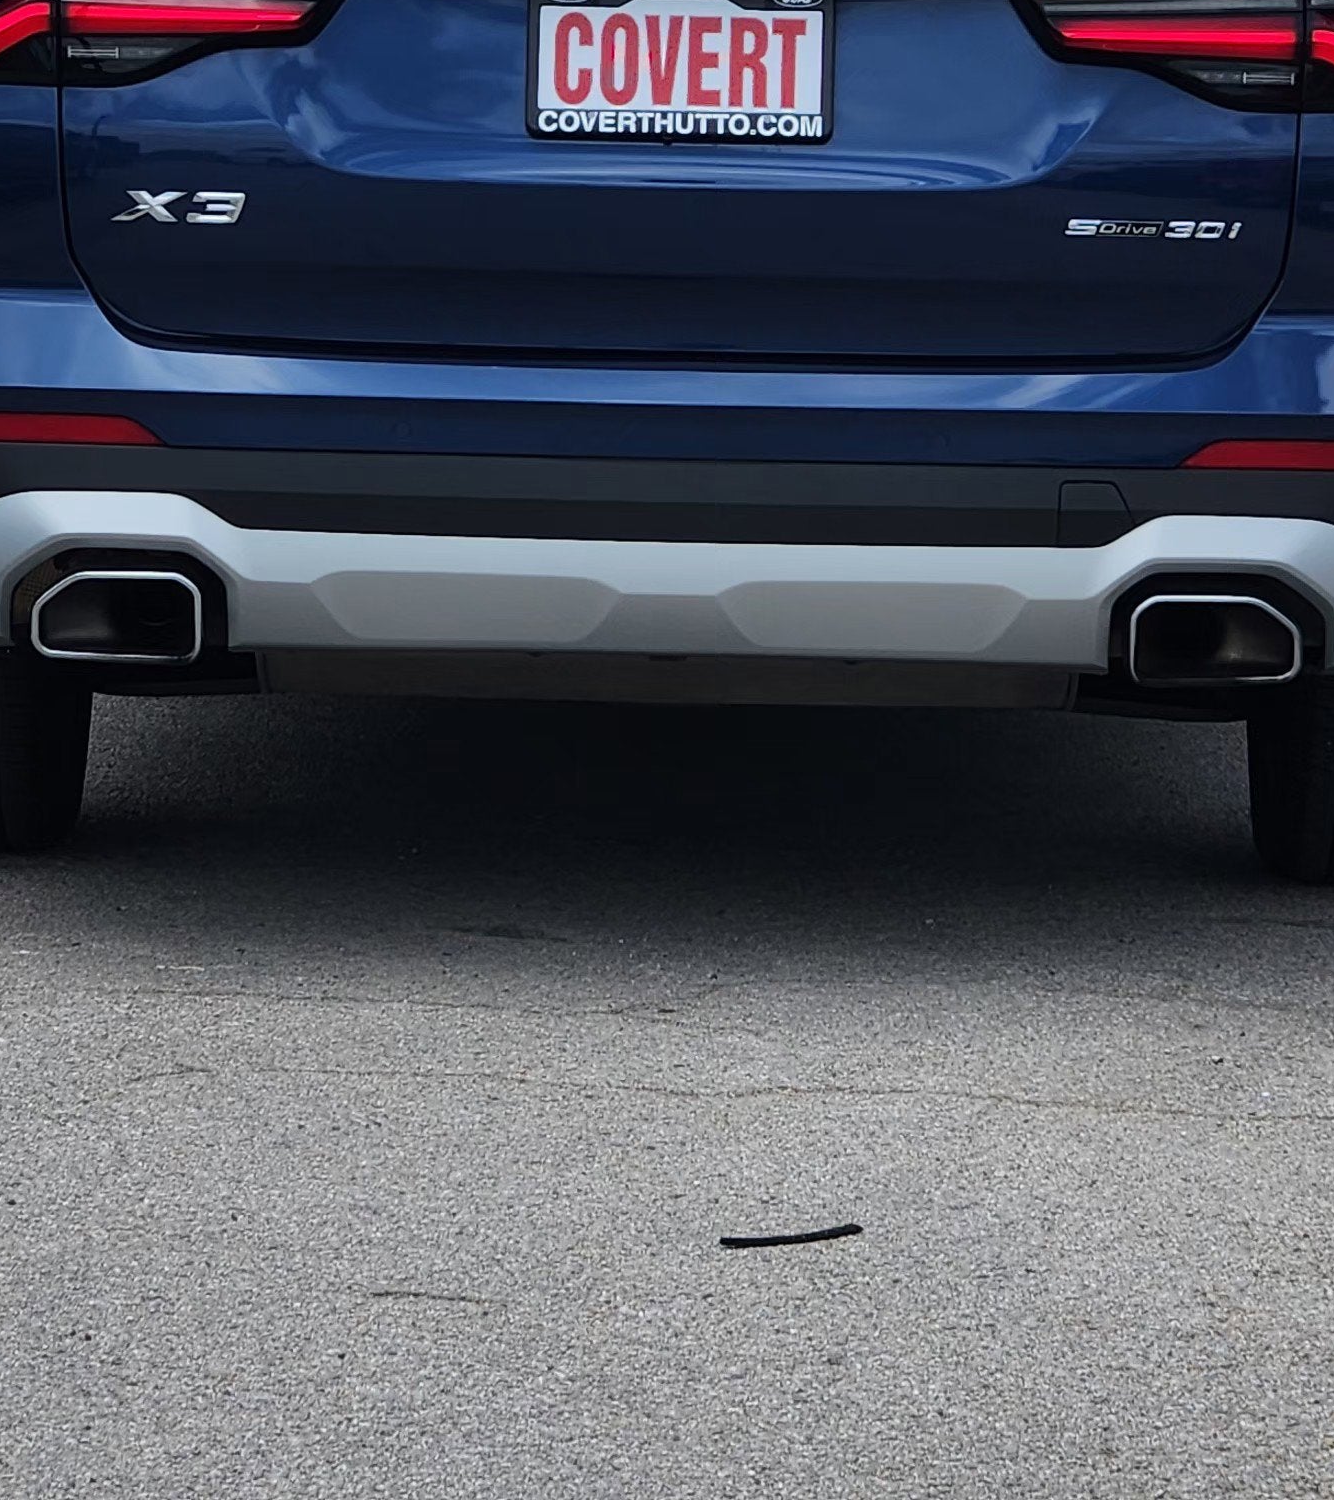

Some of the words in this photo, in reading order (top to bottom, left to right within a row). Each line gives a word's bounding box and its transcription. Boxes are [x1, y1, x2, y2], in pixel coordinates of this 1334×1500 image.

[553, 12, 807, 109] COVERT
[538, 110, 823, 137] COVERTHUTTO.COM
[110, 190, 246, 224] X3
